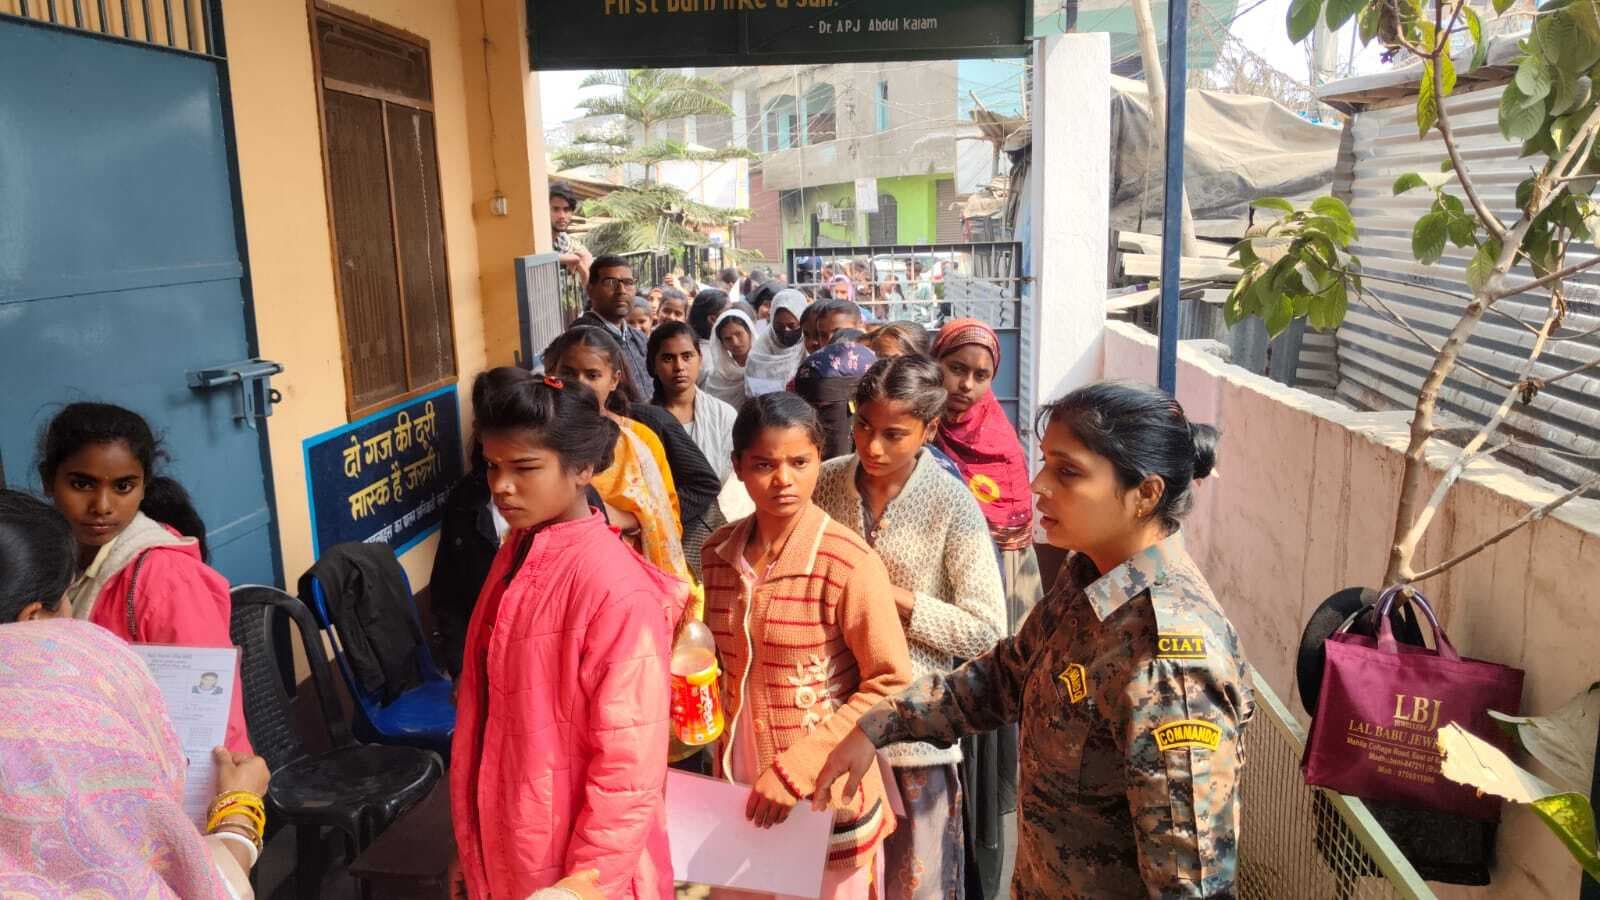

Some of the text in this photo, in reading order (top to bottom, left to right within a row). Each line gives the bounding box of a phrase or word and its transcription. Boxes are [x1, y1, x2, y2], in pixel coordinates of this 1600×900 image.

[868, 18, 898, 31] Abdul
[343, 401, 437, 479] दो गज की दूरी
[349, 476, 391, 521] मास्क
[1158, 638, 1204, 652] CIAT
[1392, 694, 1443, 732] LBJ
[1159, 725, 1218, 745] COMMANDO
[1348, 719, 1372, 734] LAL
[1375, 726, 1408, 741] BABU
